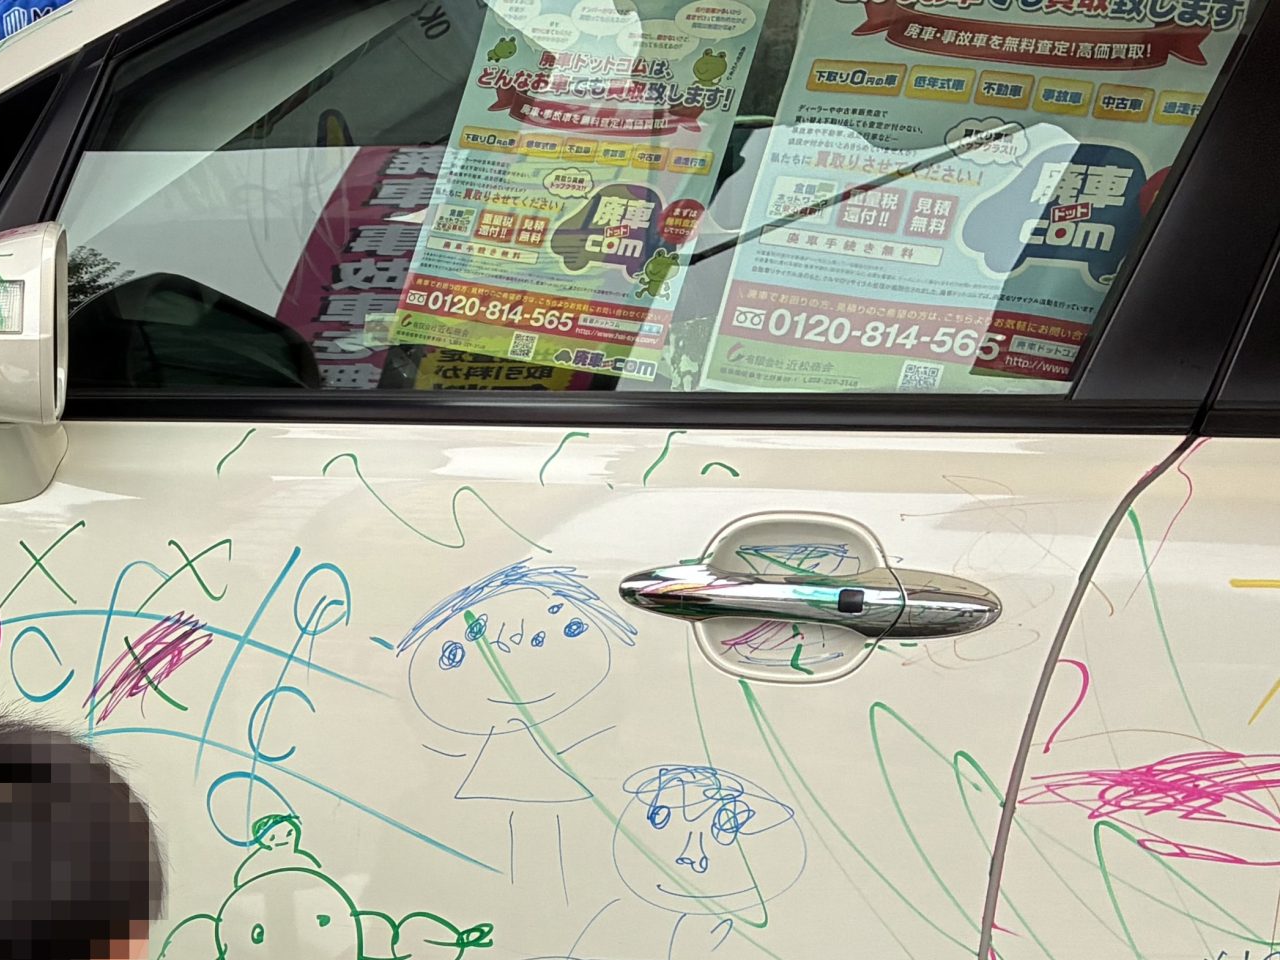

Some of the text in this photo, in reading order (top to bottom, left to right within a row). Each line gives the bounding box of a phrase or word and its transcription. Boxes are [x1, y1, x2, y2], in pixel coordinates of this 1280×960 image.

[914, 75, 965, 94] 低年式車
[983, 81, 1023, 99] 不動車
[1042, 87, 1083, 105] 事故車
[1102, 94, 1144, 112] 中古車
[637, 151, 662, 164] 中古車
[1030, 161, 1134, 208] 廃車
[594, 195, 656, 230] 廃車
[915, 197, 953, 217] 見積
[1053, 204, 1090, 222] ドット
[910, 215, 946, 235] 無料
[1019, 218, 1116, 251] com
[585, 234, 644, 258] com
[427, 291, 574, 332] 0120-814-565
[768, 307, 1001, 361] 0120-814-565
